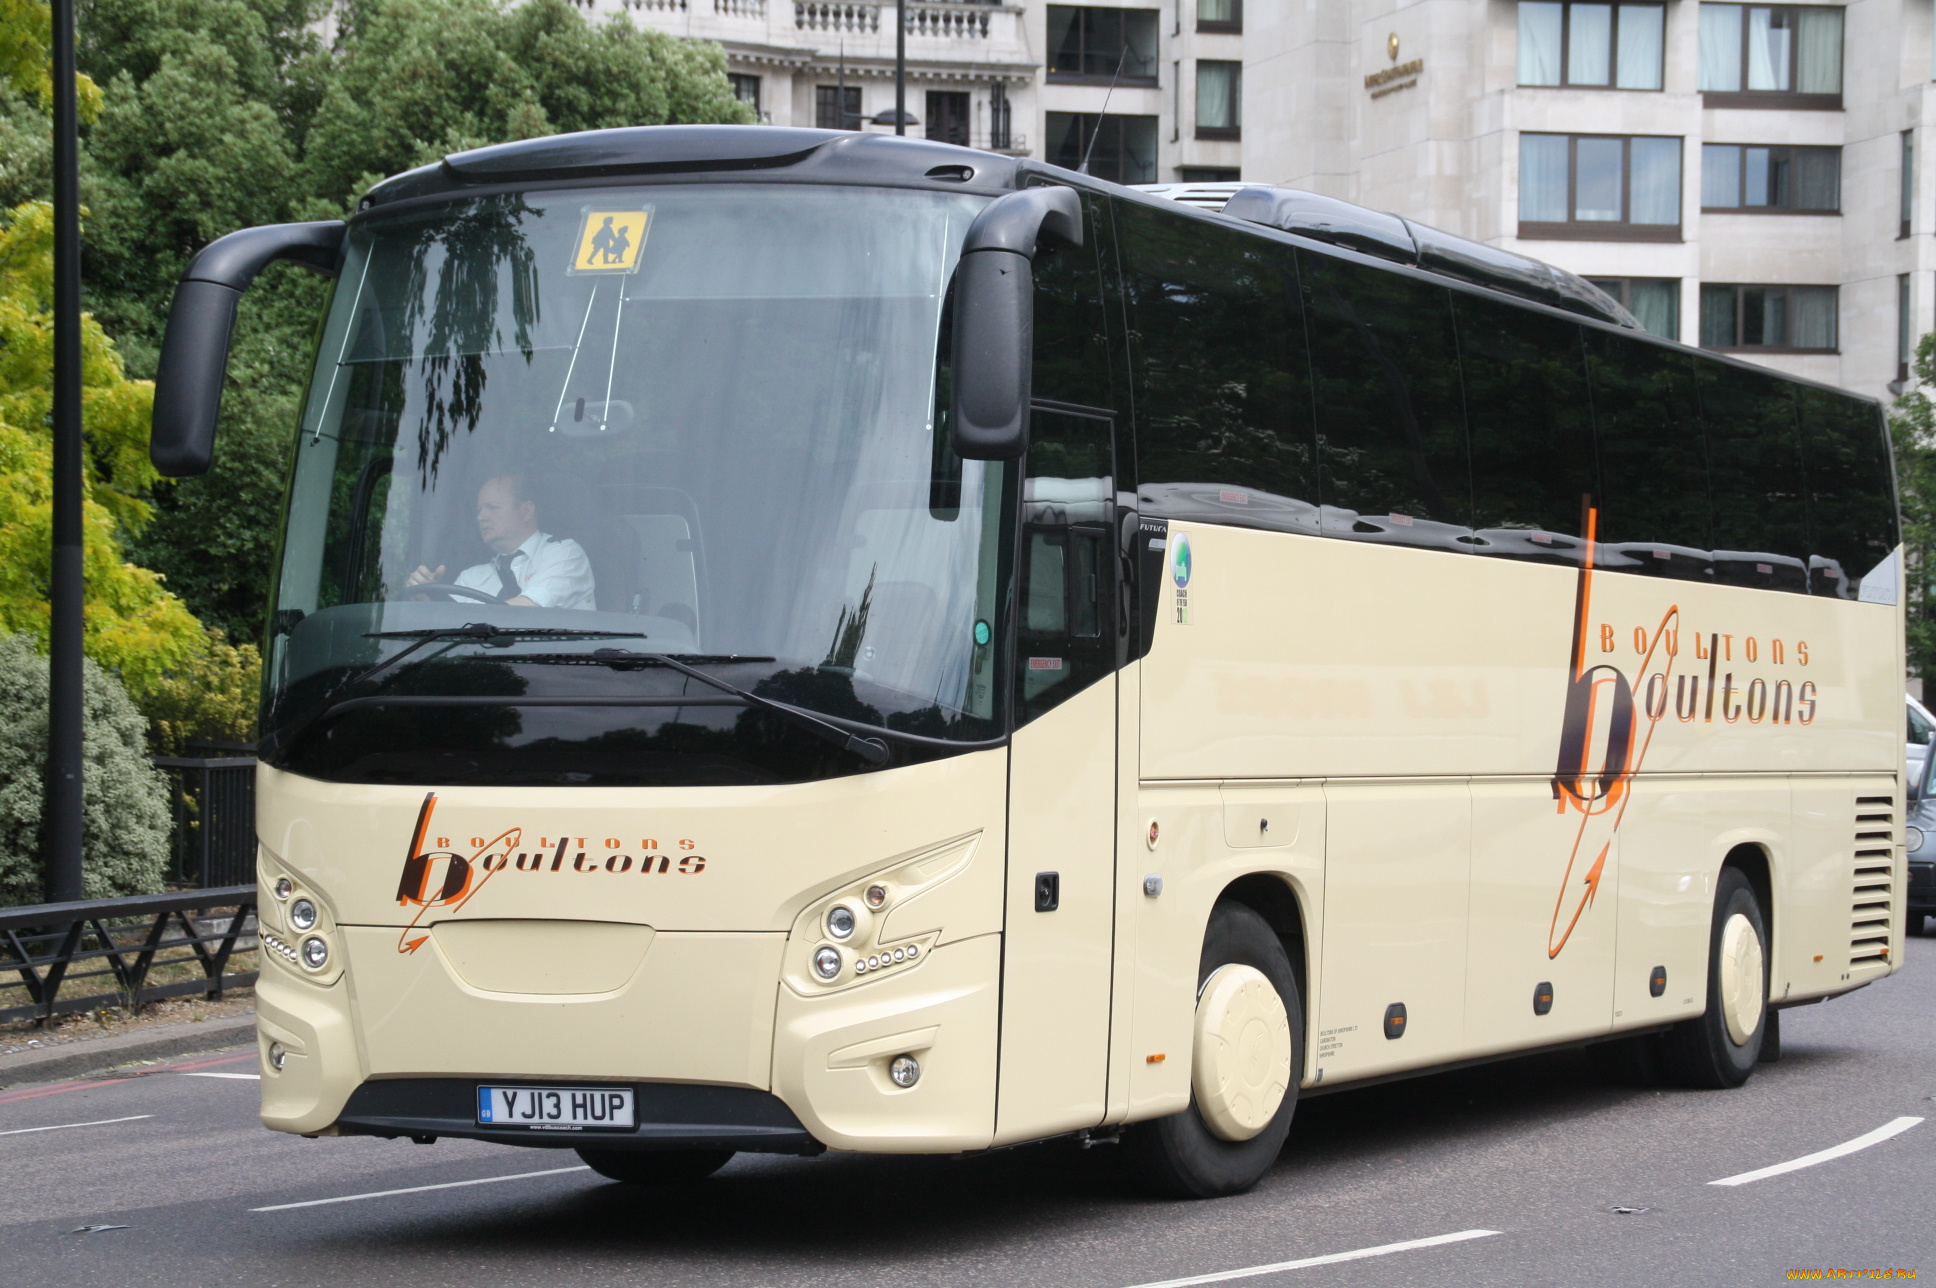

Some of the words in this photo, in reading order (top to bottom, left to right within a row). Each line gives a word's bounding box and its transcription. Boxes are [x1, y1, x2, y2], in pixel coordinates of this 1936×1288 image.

[1140, 523, 1167, 533] FUTURA
[1551, 494, 1817, 815] boultons
[1600, 623, 1809, 666] BOULTONS
[395, 791, 707, 907] boultons
[436, 836, 696, 851] BOULTONS
[481, 1109, 491, 1118] GB
[502, 1090, 562, 1119] YJ13
[571, 1092, 625, 1121] HUP
